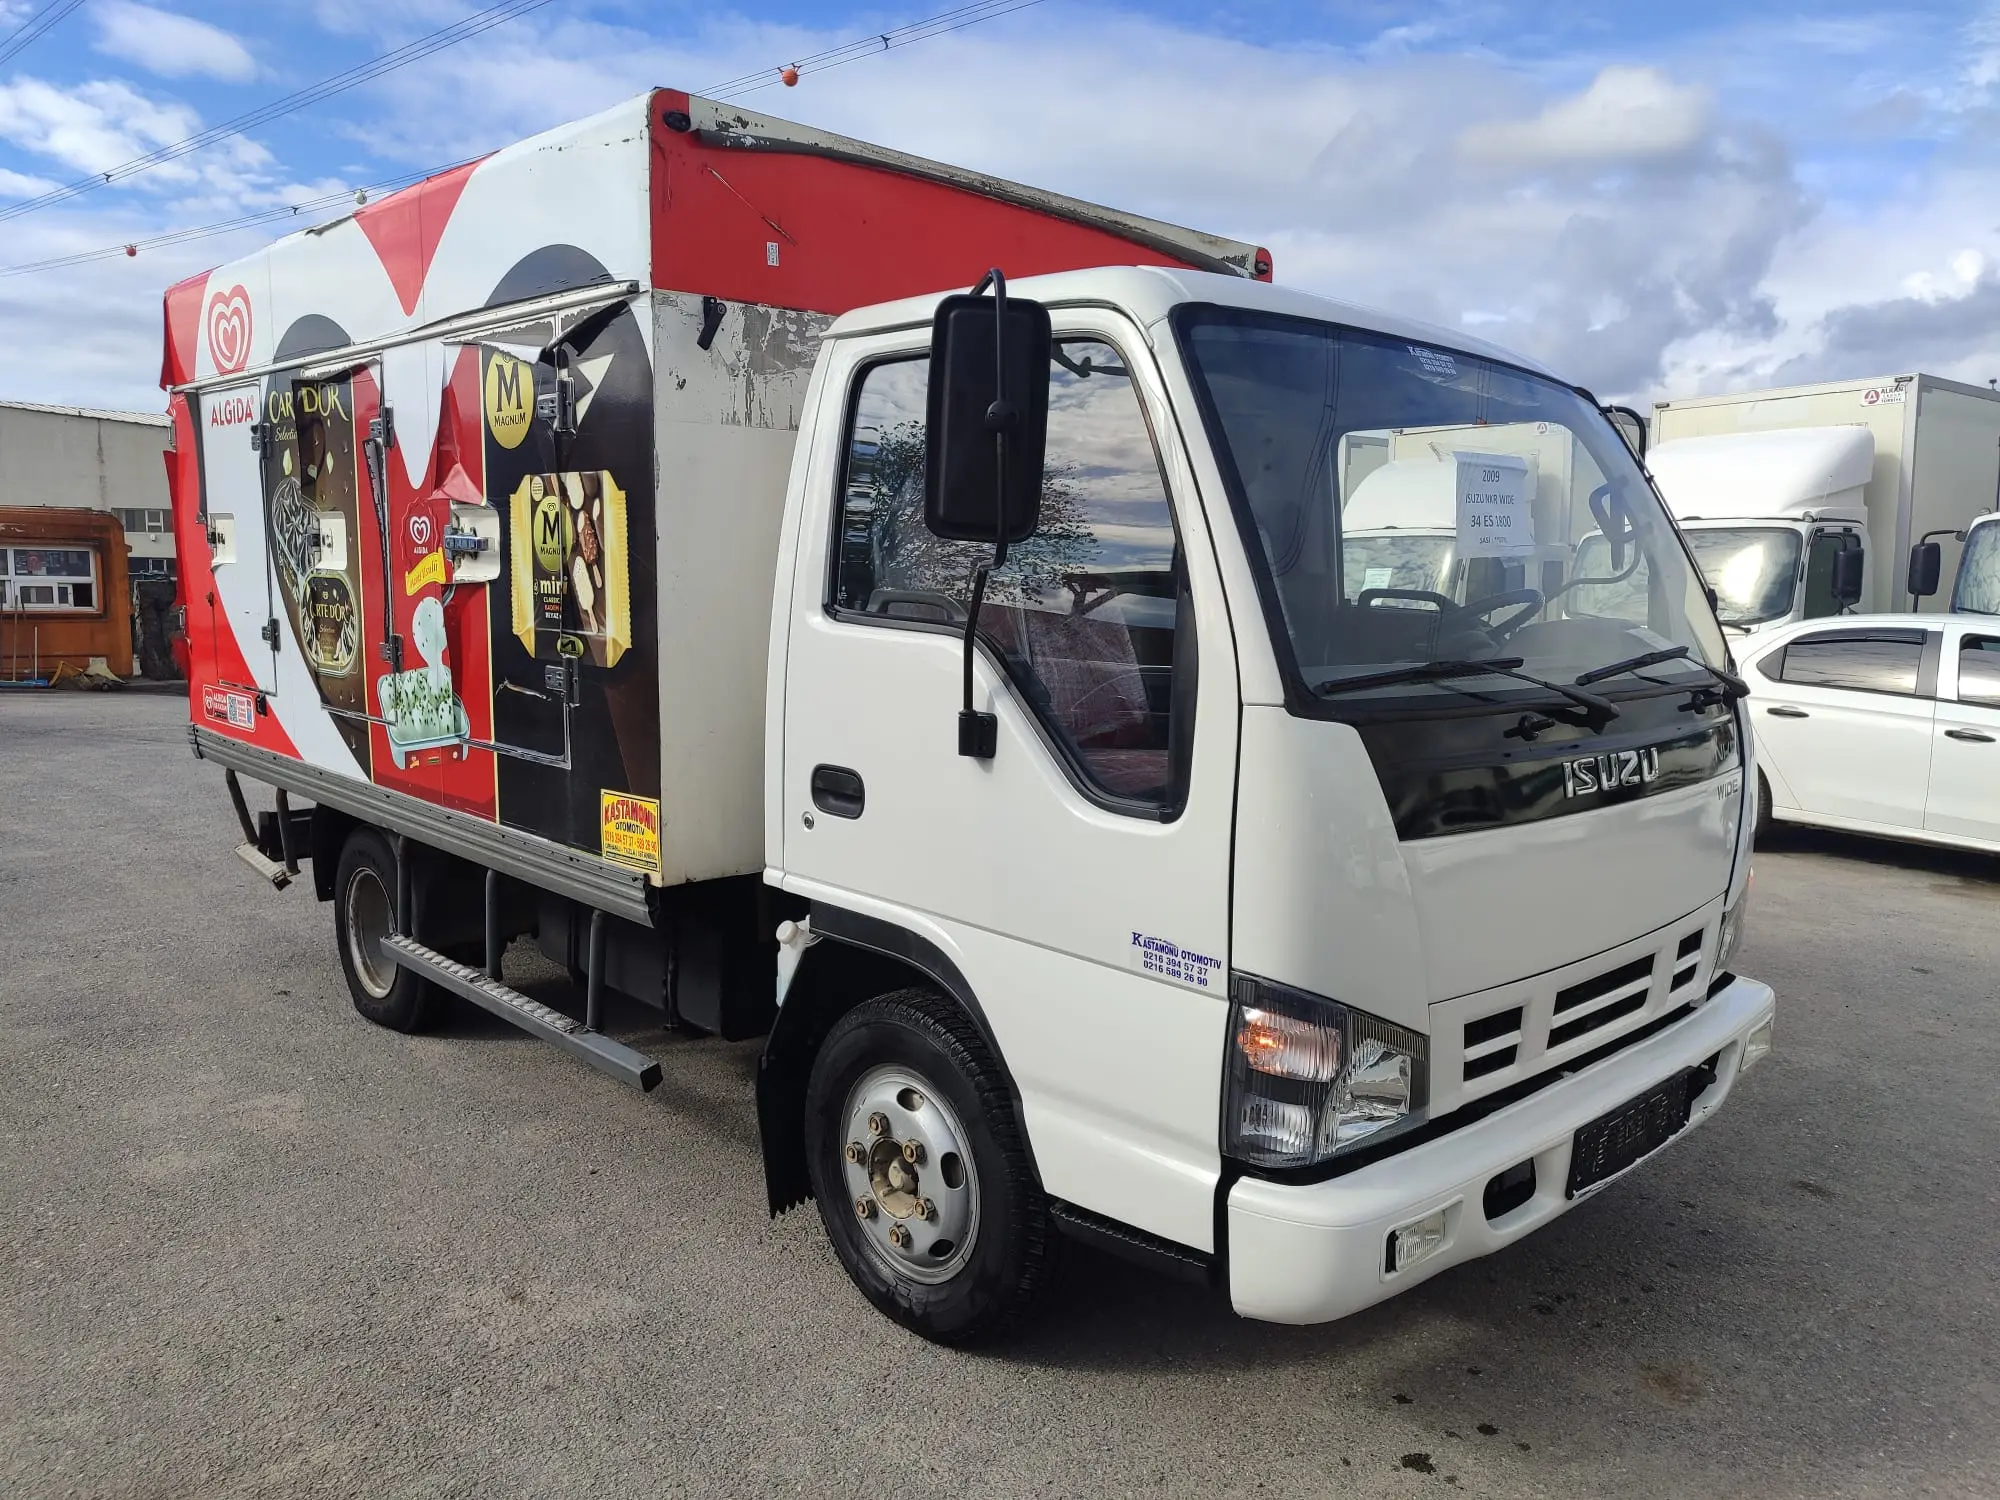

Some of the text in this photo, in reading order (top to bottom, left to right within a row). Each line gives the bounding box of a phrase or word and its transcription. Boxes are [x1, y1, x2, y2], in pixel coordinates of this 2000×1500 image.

[269, 391, 296, 423] CAR
[494, 412, 526, 427] MAGNUM
[274, 426, 298, 442] Selectio
[1482, 469, 1500, 482] 2009
[1465, 493, 1515, 505] ISUZU NKR WIDE
[1470, 515, 1481, 528] 34
[1483, 515, 1494, 527] ES
[1563, 747, 1659, 799] ISUZU
[1716, 778, 1738, 800] WIDE
[605, 800, 656, 834] KASTAMONU
[1131, 931, 1179, 957] KASTAMONU
[1143, 950, 1208, 976] 0216 394 57 37
[1143, 960, 1208, 987] 0216 589 26 90
